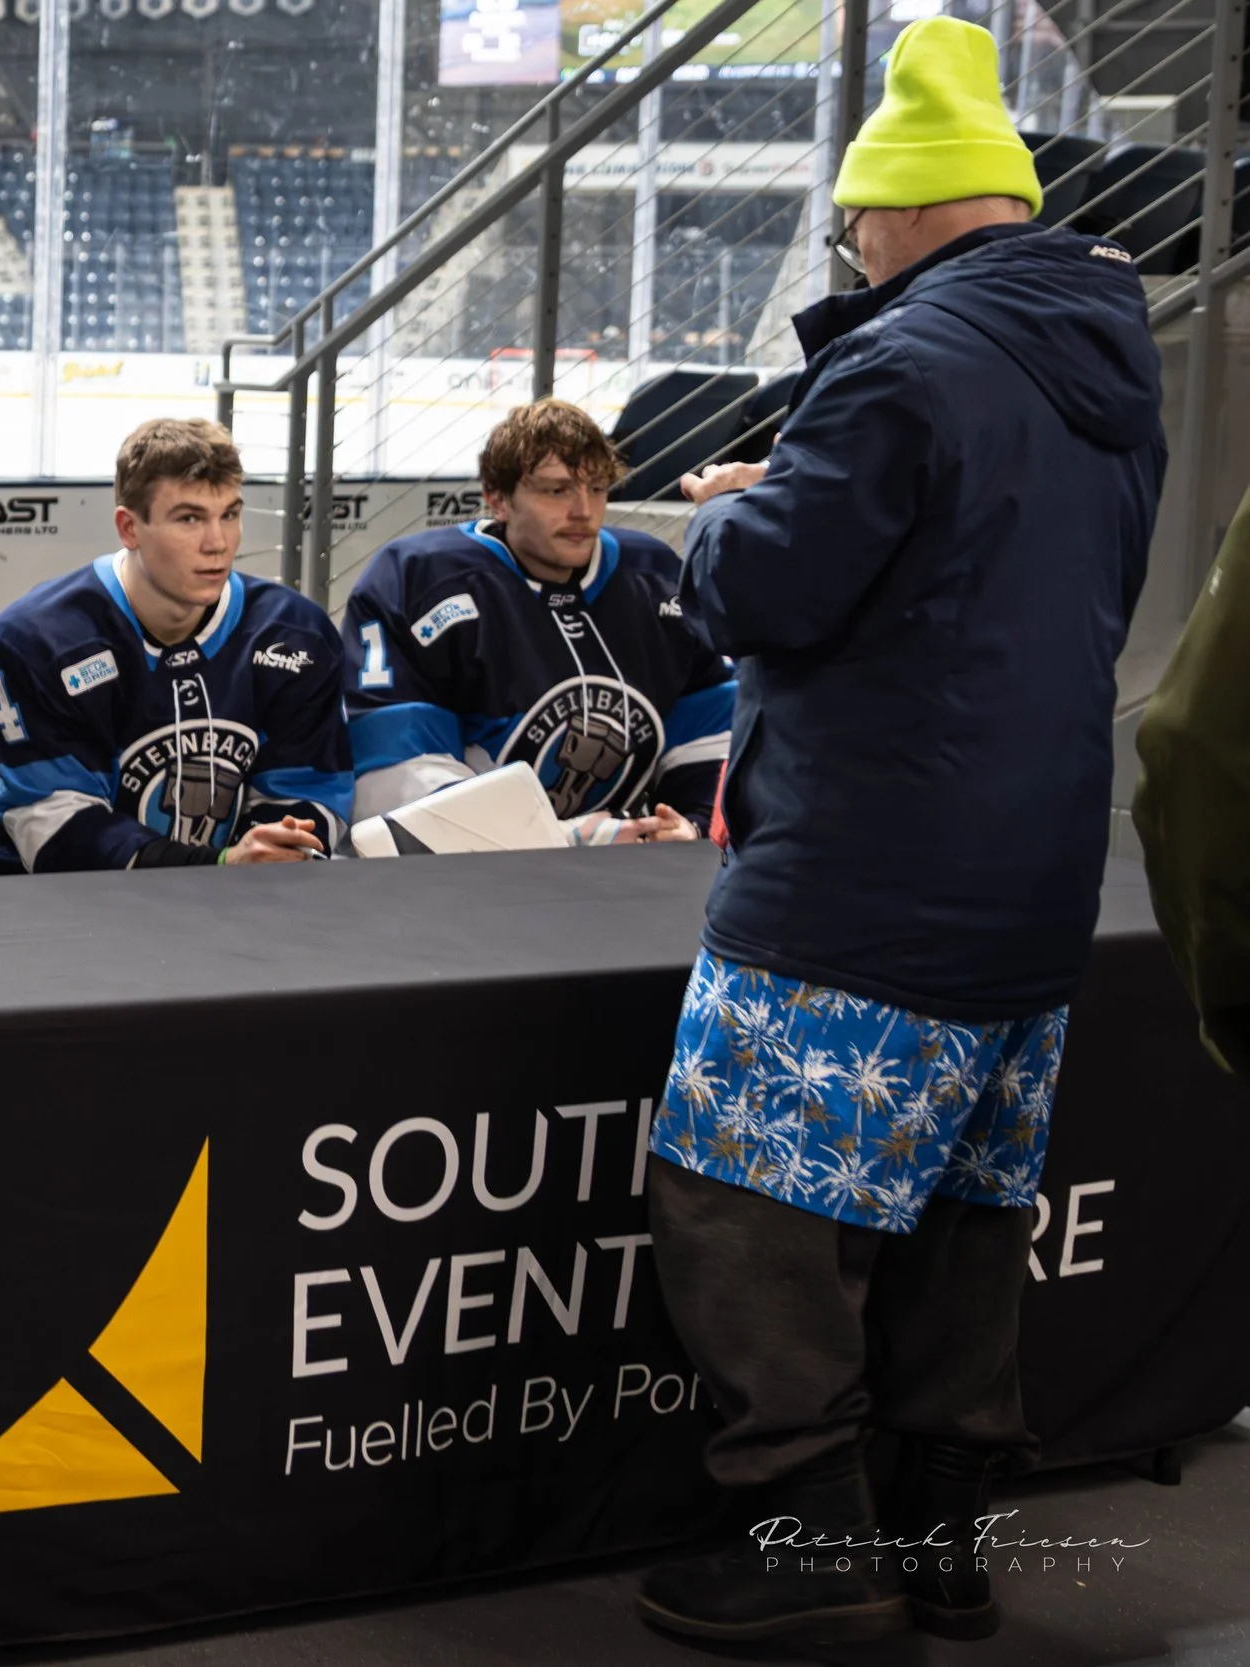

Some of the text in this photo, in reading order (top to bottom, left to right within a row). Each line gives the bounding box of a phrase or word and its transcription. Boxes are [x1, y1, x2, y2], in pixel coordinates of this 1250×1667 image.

[427, 491, 483, 517] FAS
[359, 620, 393, 689] 1
[526, 688, 653, 744] STEINBACH
[121, 731, 256, 793] STEINBACH
[292, 1233, 653, 1379] EVENT
[285, 1383, 497, 1476] Fuelled
[519, 1375, 595, 1442] By
